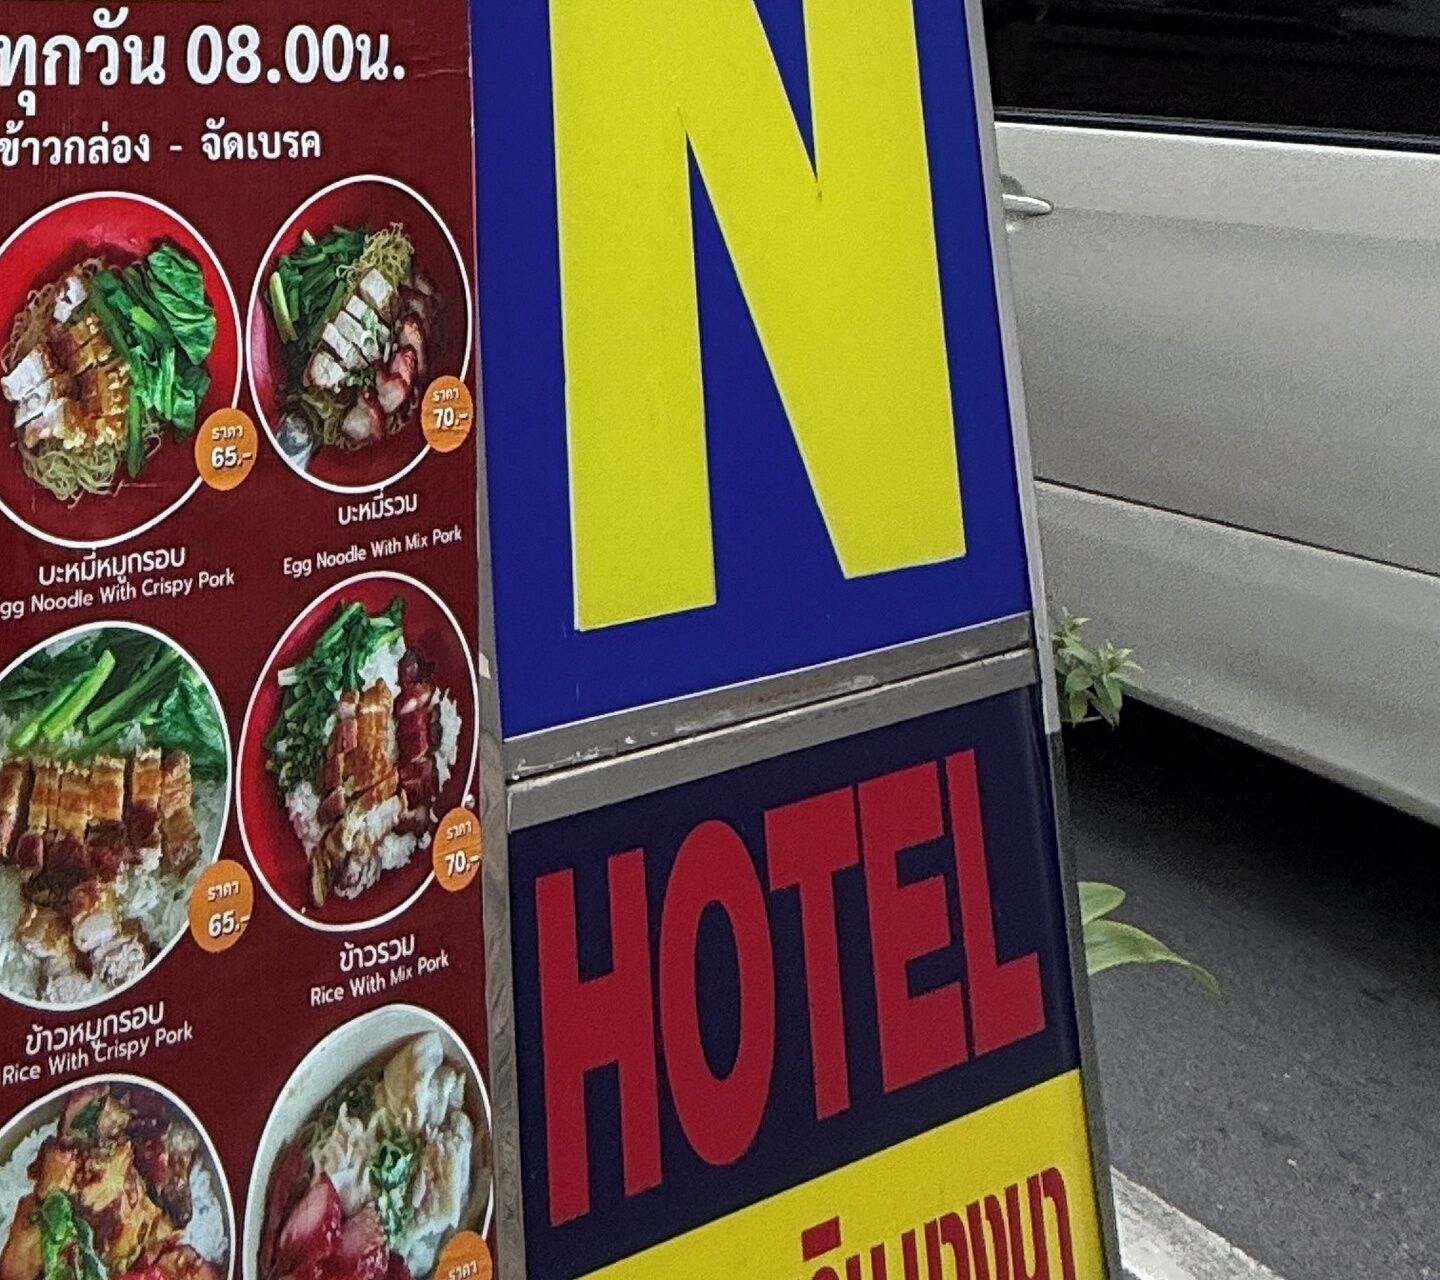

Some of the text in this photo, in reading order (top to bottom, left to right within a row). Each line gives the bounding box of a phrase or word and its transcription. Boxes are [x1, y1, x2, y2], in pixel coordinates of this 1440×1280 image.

[186, 24, 406, 85] 08.00น.
[200, 118, 322, 160] จัดเบรค
[433, 388, 460, 401] ราคา
[212, 425, 243, 440] ราคา
[283, 525, 463, 579] Egg Noodle With Mix Pork
[31, 589, 93, 613] Noodle
[100, 582, 137, 605] With
[141, 577, 194, 598] Crispy
[198, 567, 236, 590] Pork
[446, 821, 472, 840] ราคา
[208, 881, 240, 901] ราคา
[339, 933, 415, 972] ข้าวรวม
[310, 949, 449, 1007] Rice With Mix Pork
[535, 748, 1046, 1226] HOTEL
[25, 1001, 165, 1056] ข้าวหมูกรอบ
[2, 1021, 193, 1086] Rice With Crispy Pork
